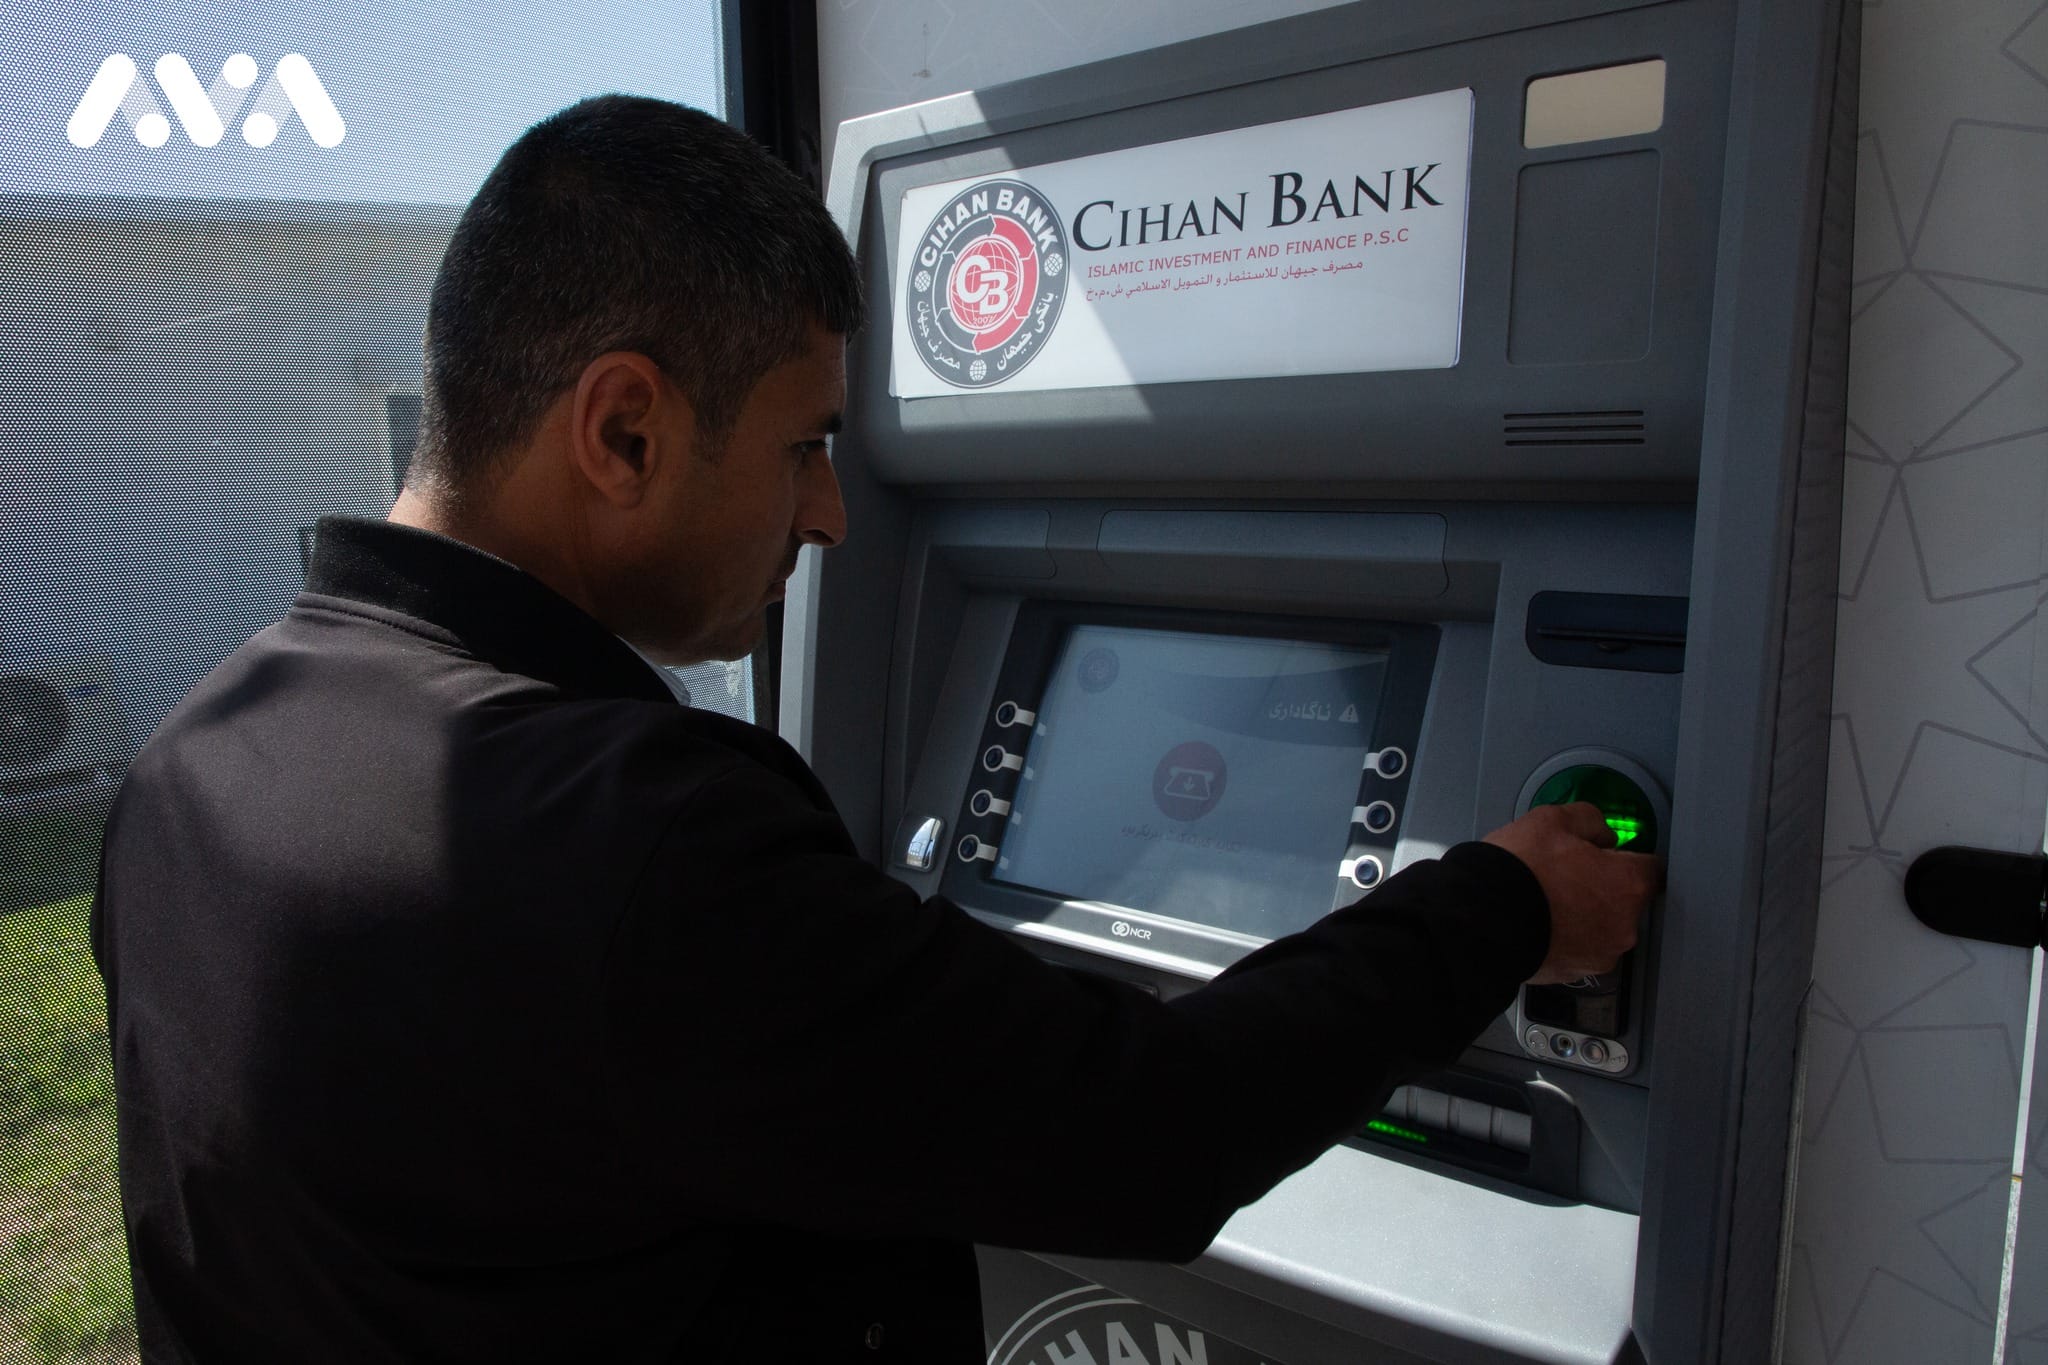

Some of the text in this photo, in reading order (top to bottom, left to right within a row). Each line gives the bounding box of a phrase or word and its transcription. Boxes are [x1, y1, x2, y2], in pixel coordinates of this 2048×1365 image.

[1072, 162, 1444, 252] CIHAN BANK
[920, 188, 1058, 268] CIHAN BANK
[1087, 228, 1409, 279] ISLAMIC INVESTMENT AND FINANCE P.S.C
[1322, 260, 1364, 274] مصرف
[956, 254, 1009, 315] CB
[1173, 273, 1213, 291] التمويل
[1223, 266, 1279, 286] للاستثمار
[927, 339, 961, 370] مصرف
[1129, 926, 1152, 941] NCR
